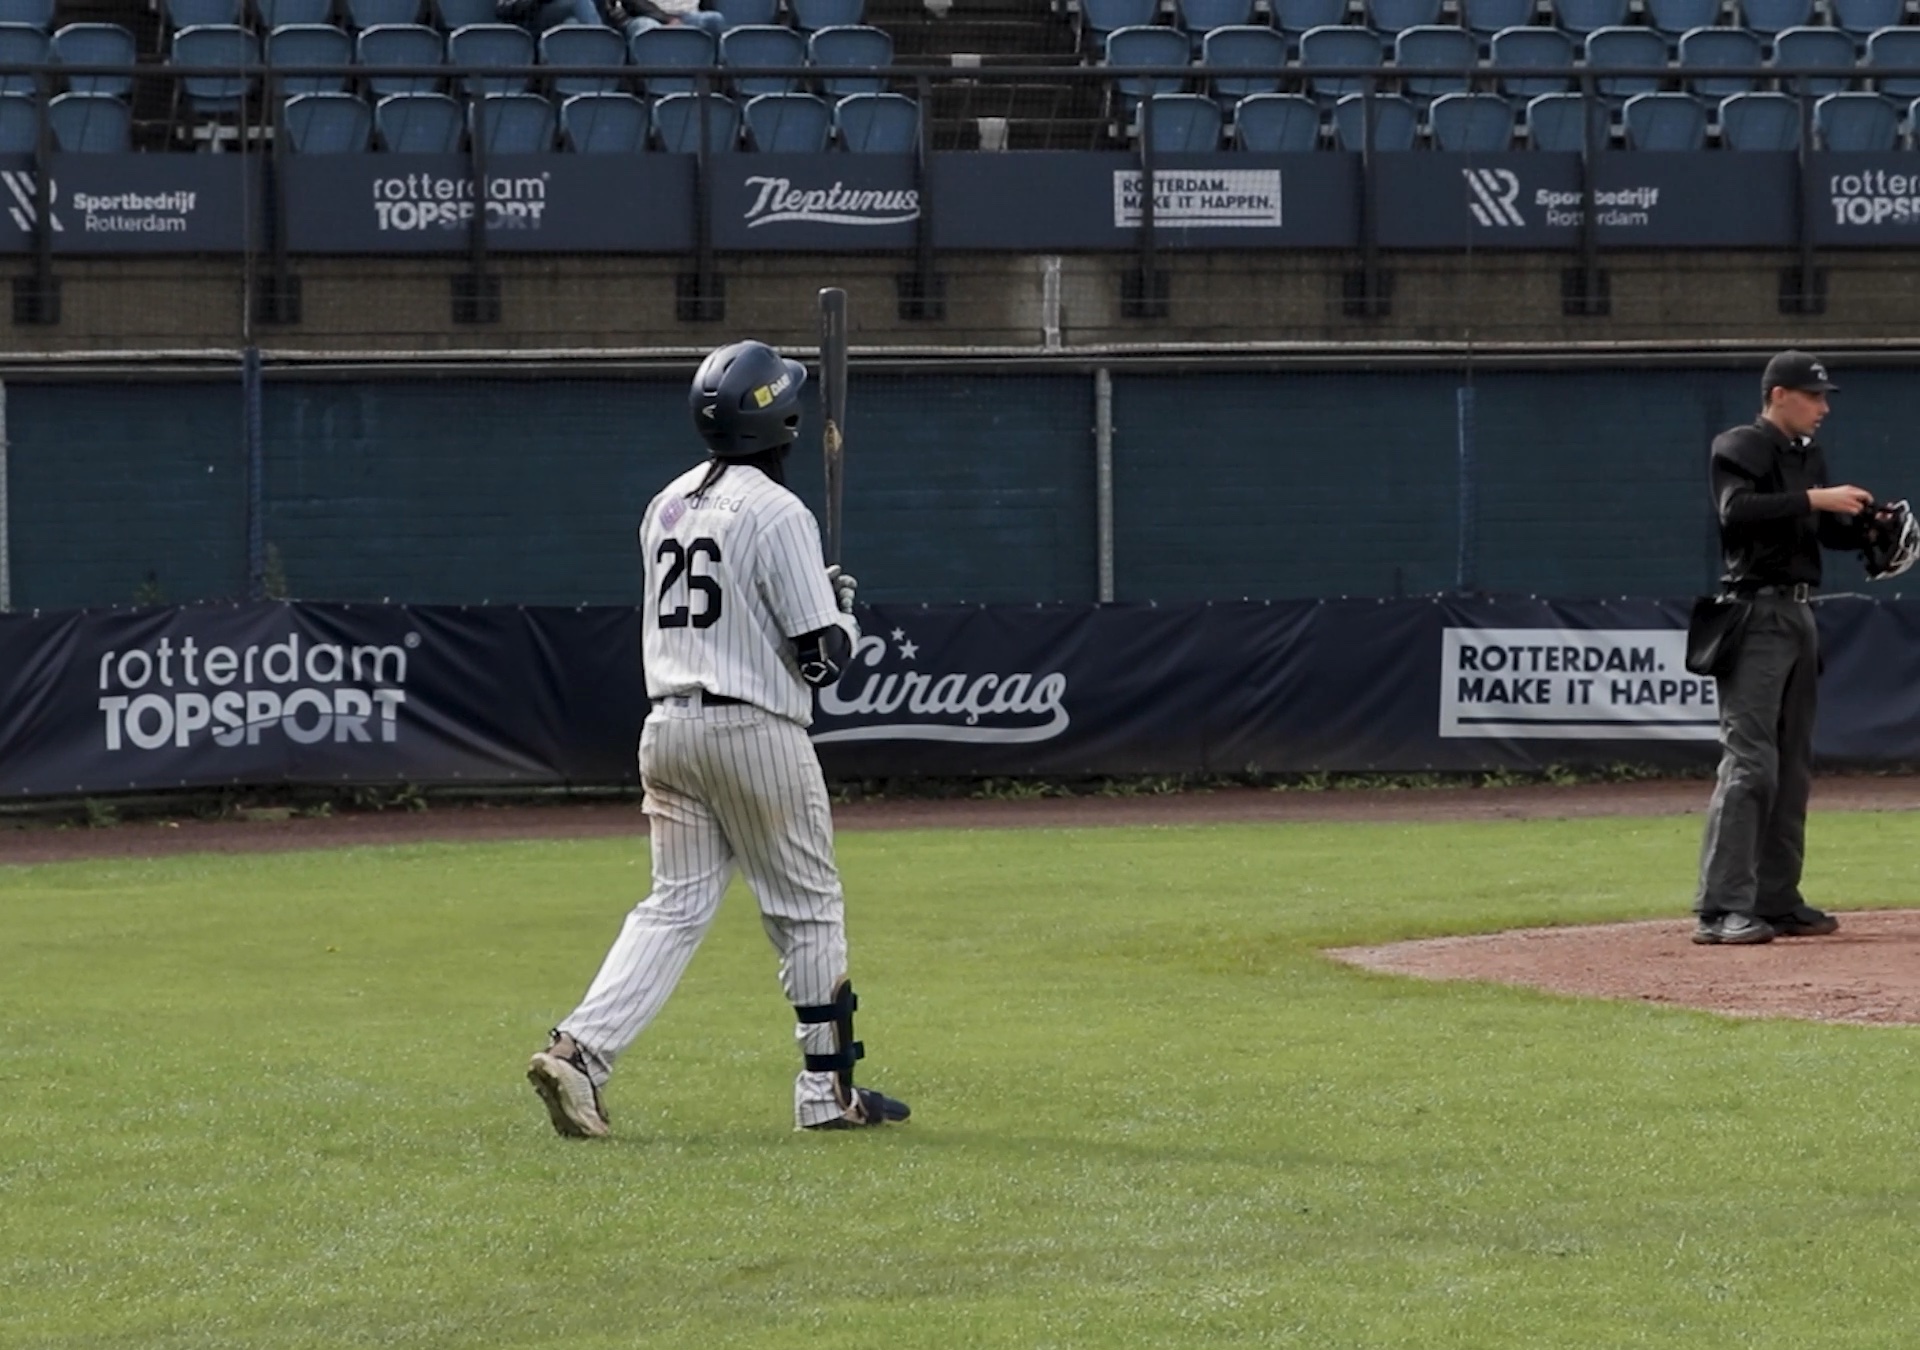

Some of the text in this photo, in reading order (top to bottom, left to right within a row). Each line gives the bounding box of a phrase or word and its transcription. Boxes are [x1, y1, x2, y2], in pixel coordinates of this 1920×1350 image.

[744, 175, 921, 220] Neptunus
[1123, 179, 1230, 193] ROTERDAM.
[1535, 187, 1660, 209] Sporbedrijf
[73, 191, 197, 214] Sportbedrijf
[1178, 195, 1192, 209] IT
[1200, 195, 1275, 209] HAPPEN.
[85, 214, 187, 232] Rotterdam
[656, 537, 722, 629] 26
[1458, 644, 1666, 673] ROTTERDAM.
[819, 635, 1068, 726] Curaçao
[1457, 677, 1552, 704] MAKE
[1567, 679, 1594, 705] IT
[98, 688, 406, 750] TOPSPORT
